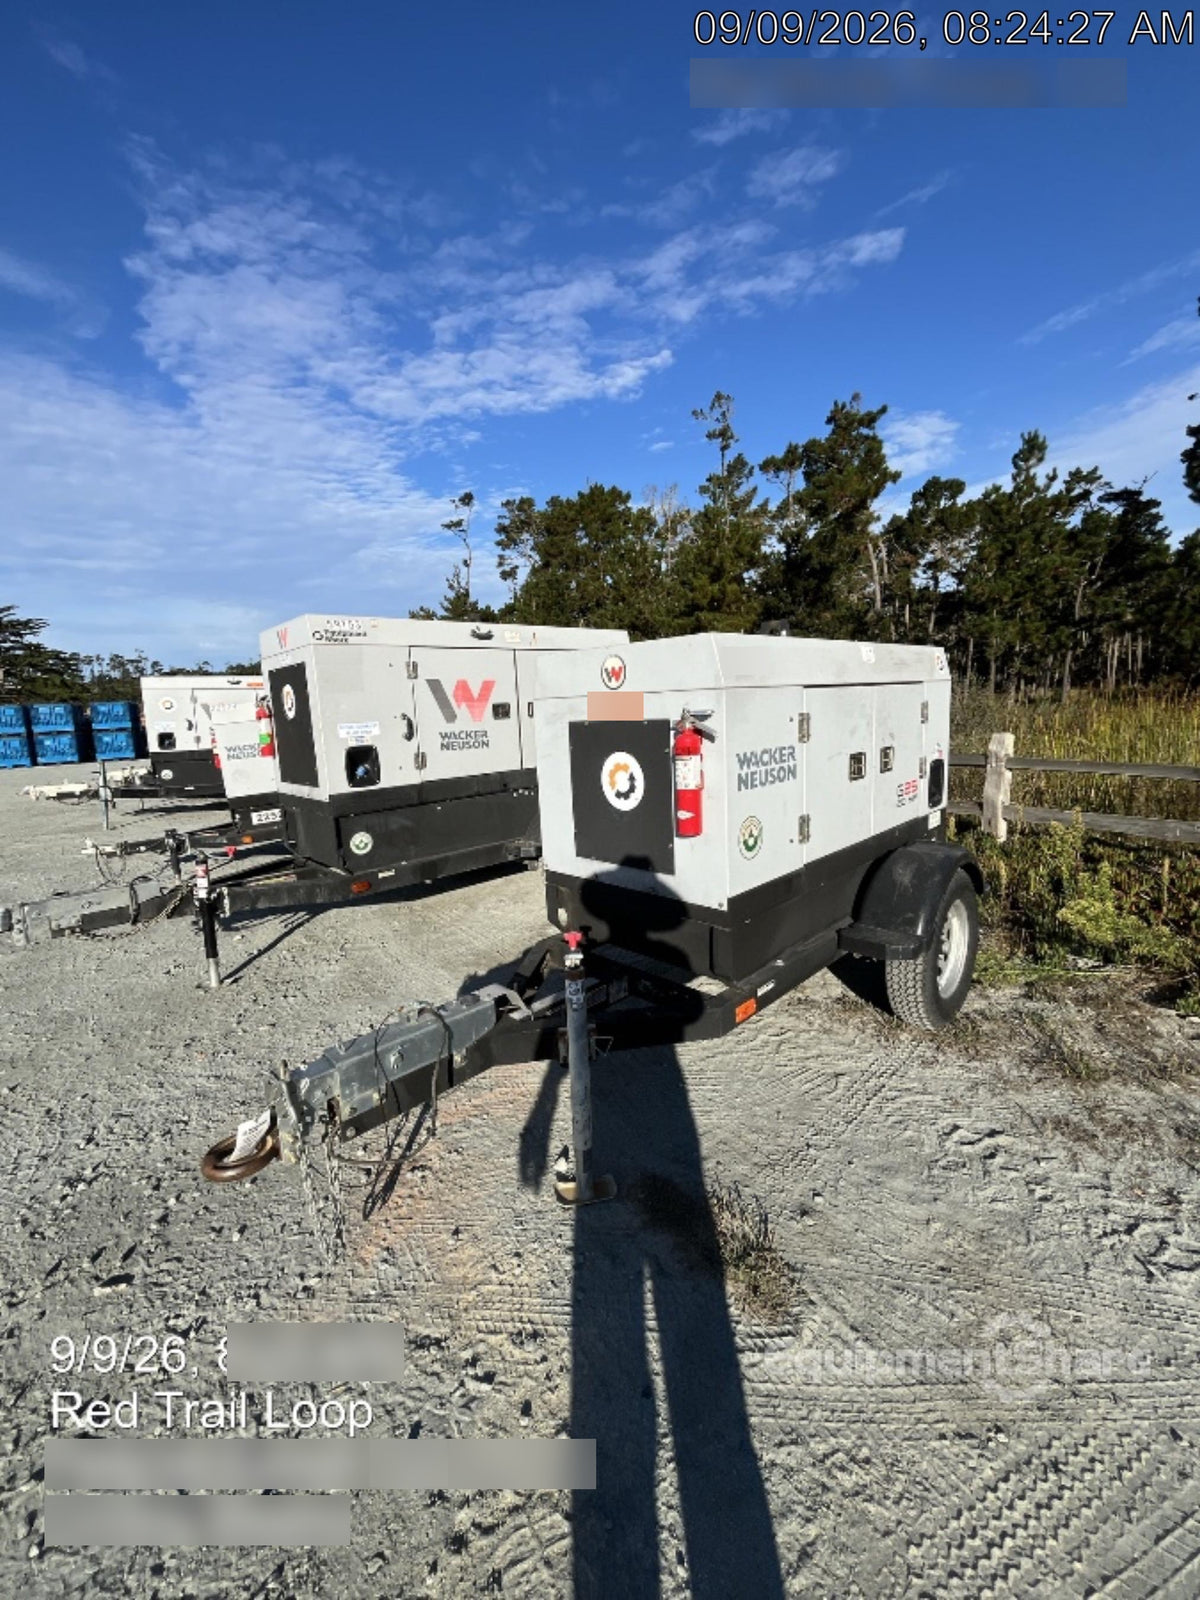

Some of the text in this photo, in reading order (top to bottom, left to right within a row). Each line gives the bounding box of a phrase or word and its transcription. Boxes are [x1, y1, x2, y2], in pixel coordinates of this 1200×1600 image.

[438, 730, 488, 740] WACKER
[440, 740, 490, 751] NEUSON
[736, 745, 797, 771] WACKER
[737, 763, 797, 792] NEUSON
